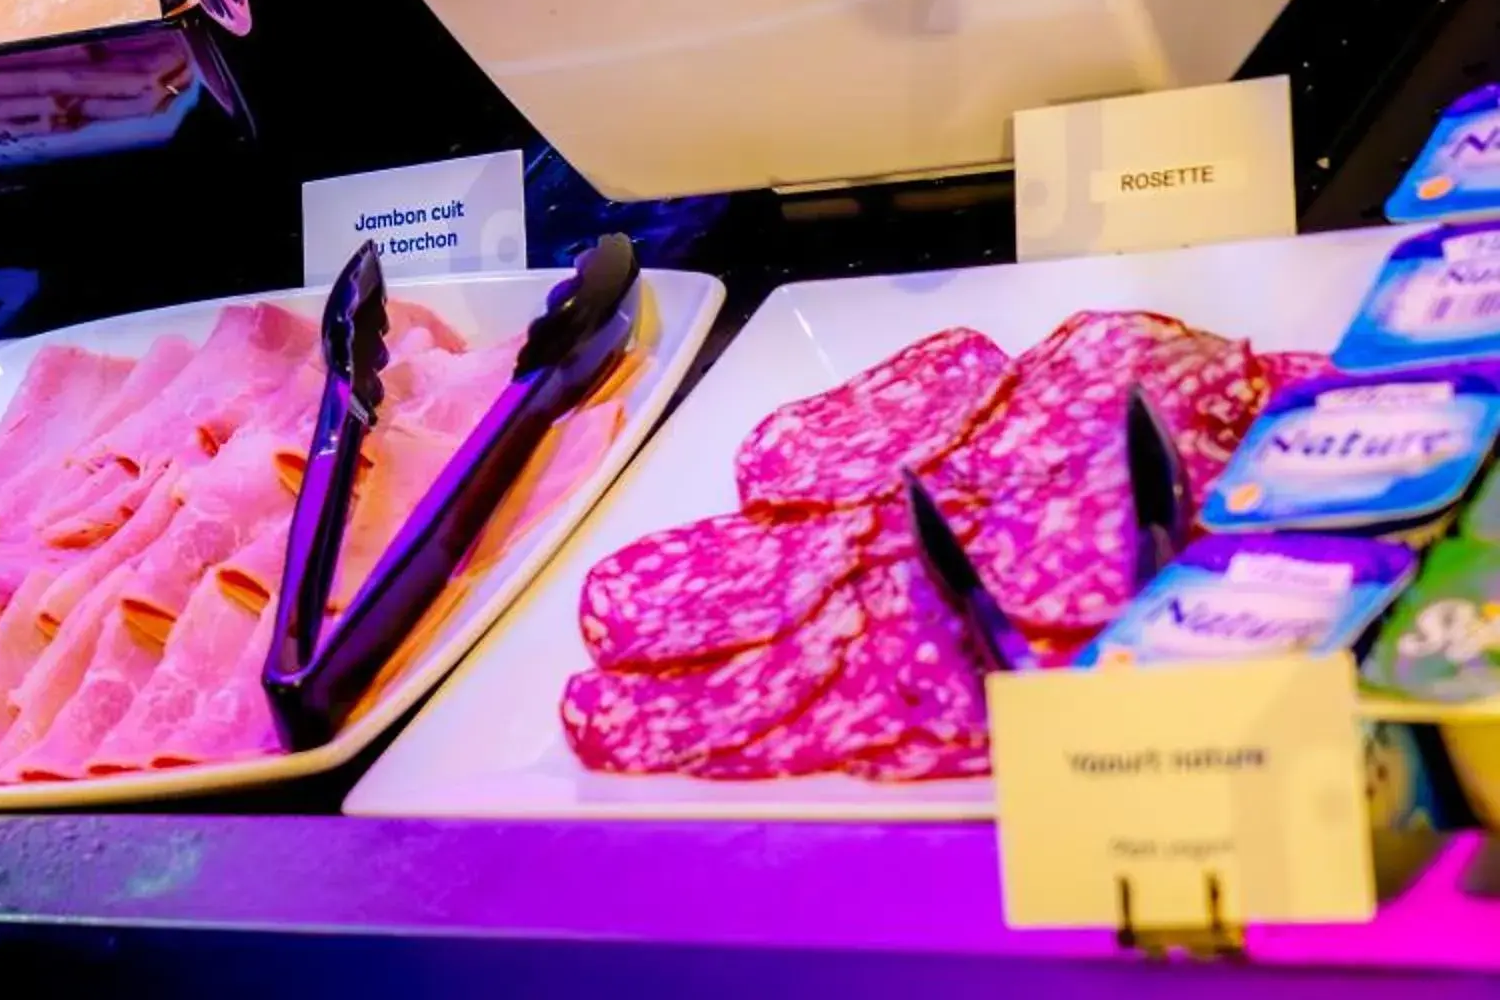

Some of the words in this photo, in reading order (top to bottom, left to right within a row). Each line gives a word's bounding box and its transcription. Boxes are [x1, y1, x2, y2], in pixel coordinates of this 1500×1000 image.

[1120, 165, 1214, 192] ROSETTE
[355, 209, 426, 231] Jambon
[431, 200, 464, 221] cuit
[389, 231, 457, 254] torchon
[1258, 430, 1449, 461] Nature
